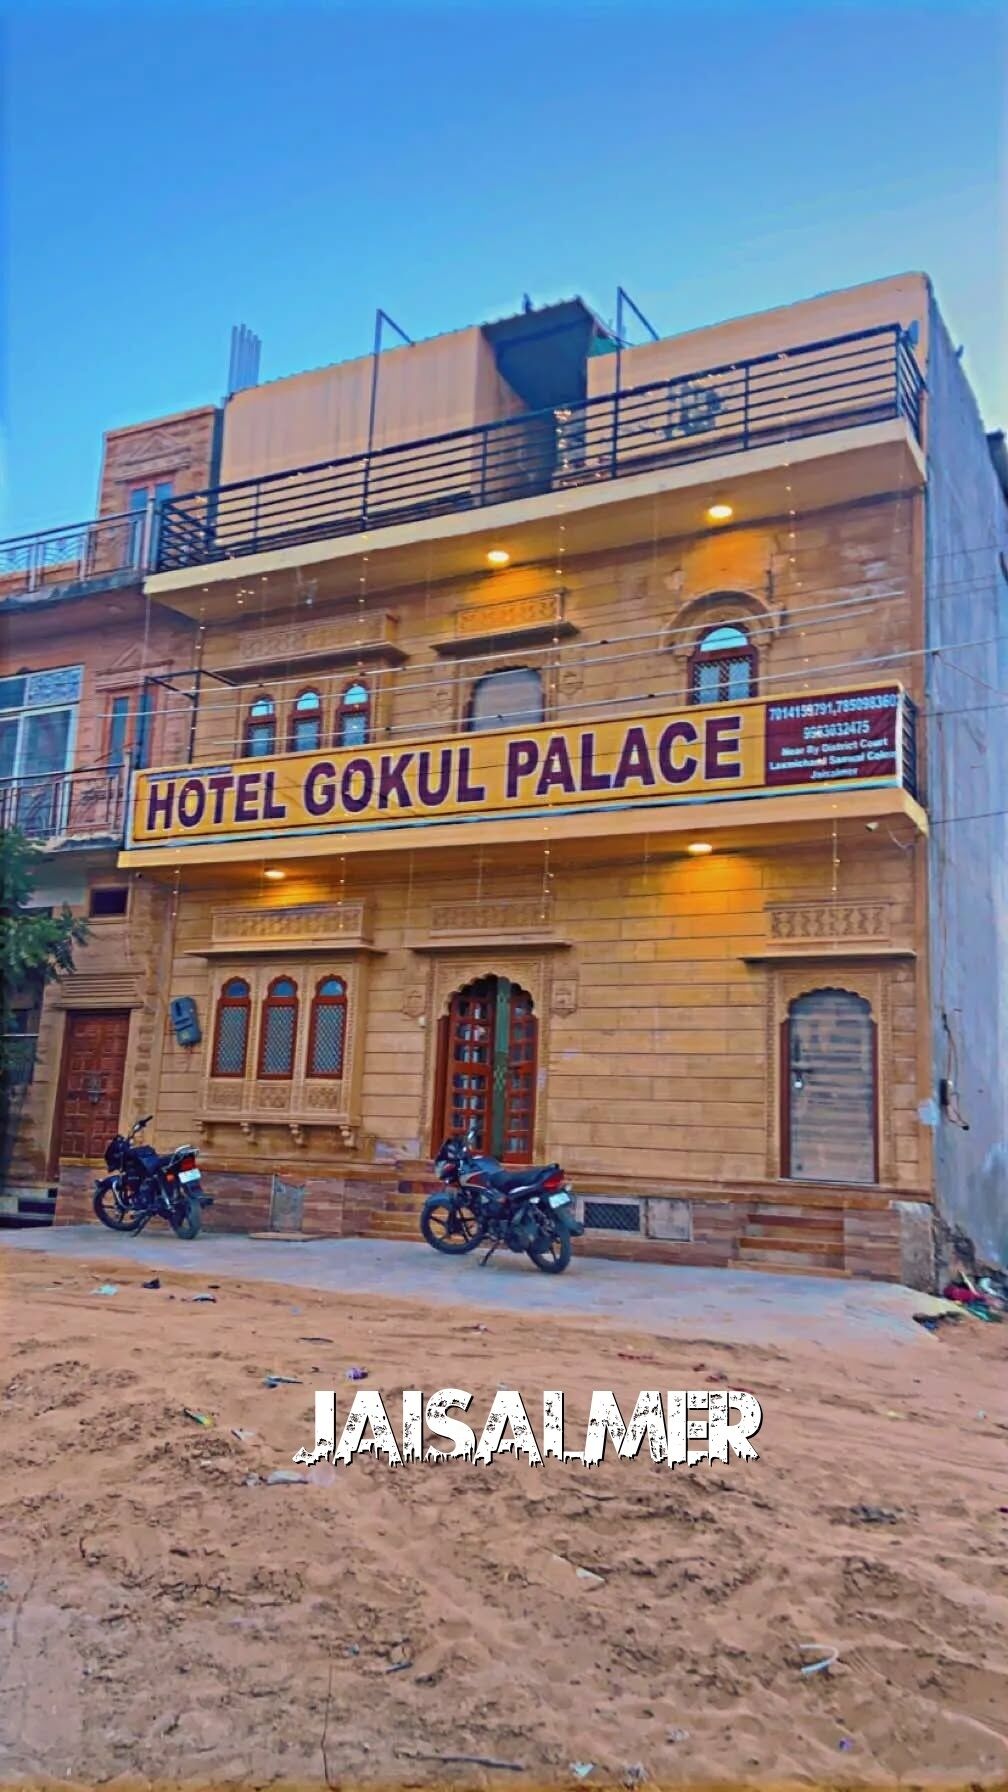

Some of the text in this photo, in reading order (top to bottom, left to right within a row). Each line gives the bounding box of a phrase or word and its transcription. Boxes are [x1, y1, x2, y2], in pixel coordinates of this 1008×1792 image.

[821, 741, 858, 752] District
[859, 738, 888, 749] Court
[866, 750, 897, 761] Colon
[145, 715, 744, 832] HOTEL GOKUL PALACE
